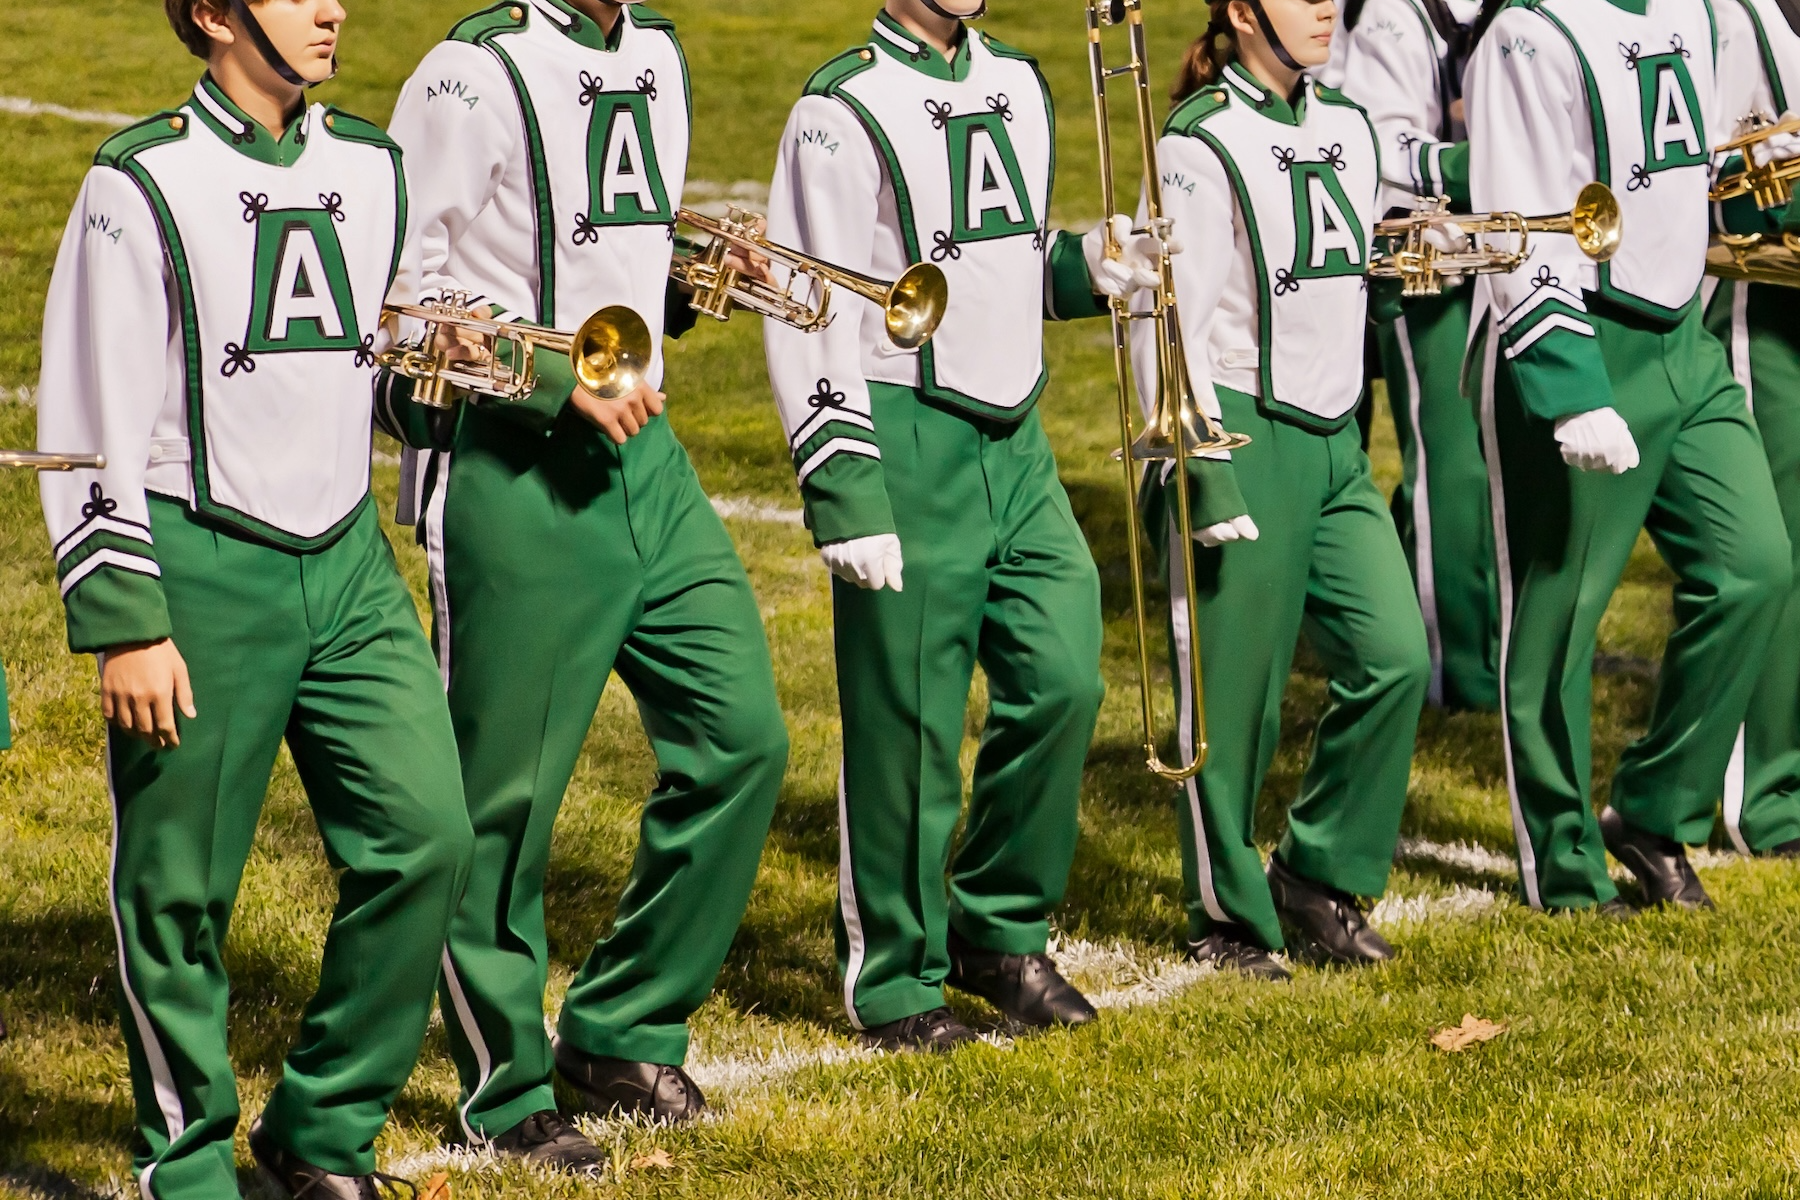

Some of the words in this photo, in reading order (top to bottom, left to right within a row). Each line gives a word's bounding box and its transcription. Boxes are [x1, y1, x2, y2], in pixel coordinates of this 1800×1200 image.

[426, 79, 480, 111] ANNA
[1653, 63, 1702, 162] A
[599, 103, 661, 215] A
[964, 123, 1027, 231] A
[1161, 172, 1197, 197] NNA
[85, 212, 122, 245] NNA
[1305, 172, 1361, 269] A
[263, 220, 348, 342] A
